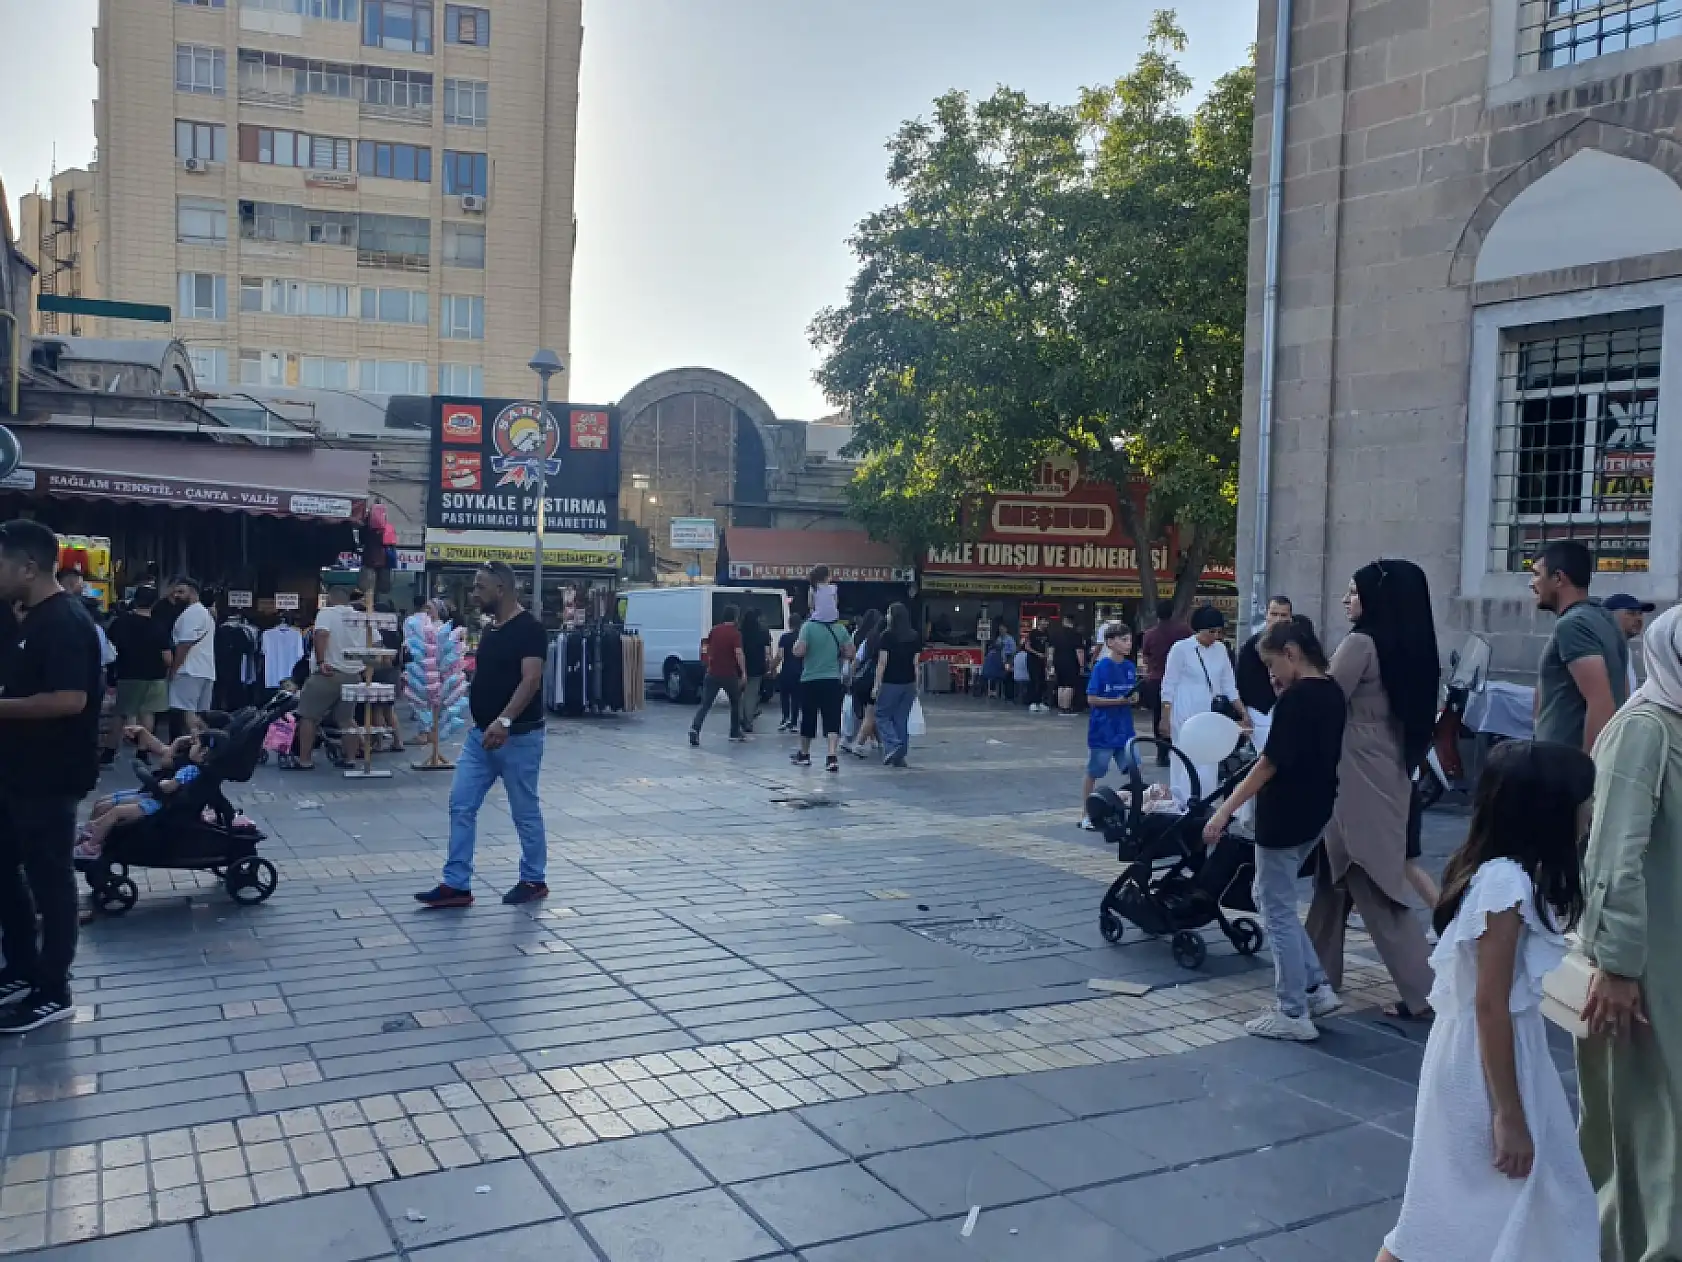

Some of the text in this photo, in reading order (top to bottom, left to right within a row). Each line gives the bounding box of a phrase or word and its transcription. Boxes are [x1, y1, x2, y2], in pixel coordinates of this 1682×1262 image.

[113, 481, 174, 497] TEKSTİL
[185, 486, 230, 501] ÇANTA
[240, 492, 279, 505] VALİZ
[441, 492, 517, 511] SOYKALE
[441, 512, 518, 528] PASTIRMACI
[977, 543, 1039, 569] TURŞU
[1043, 546, 1067, 567] VE
